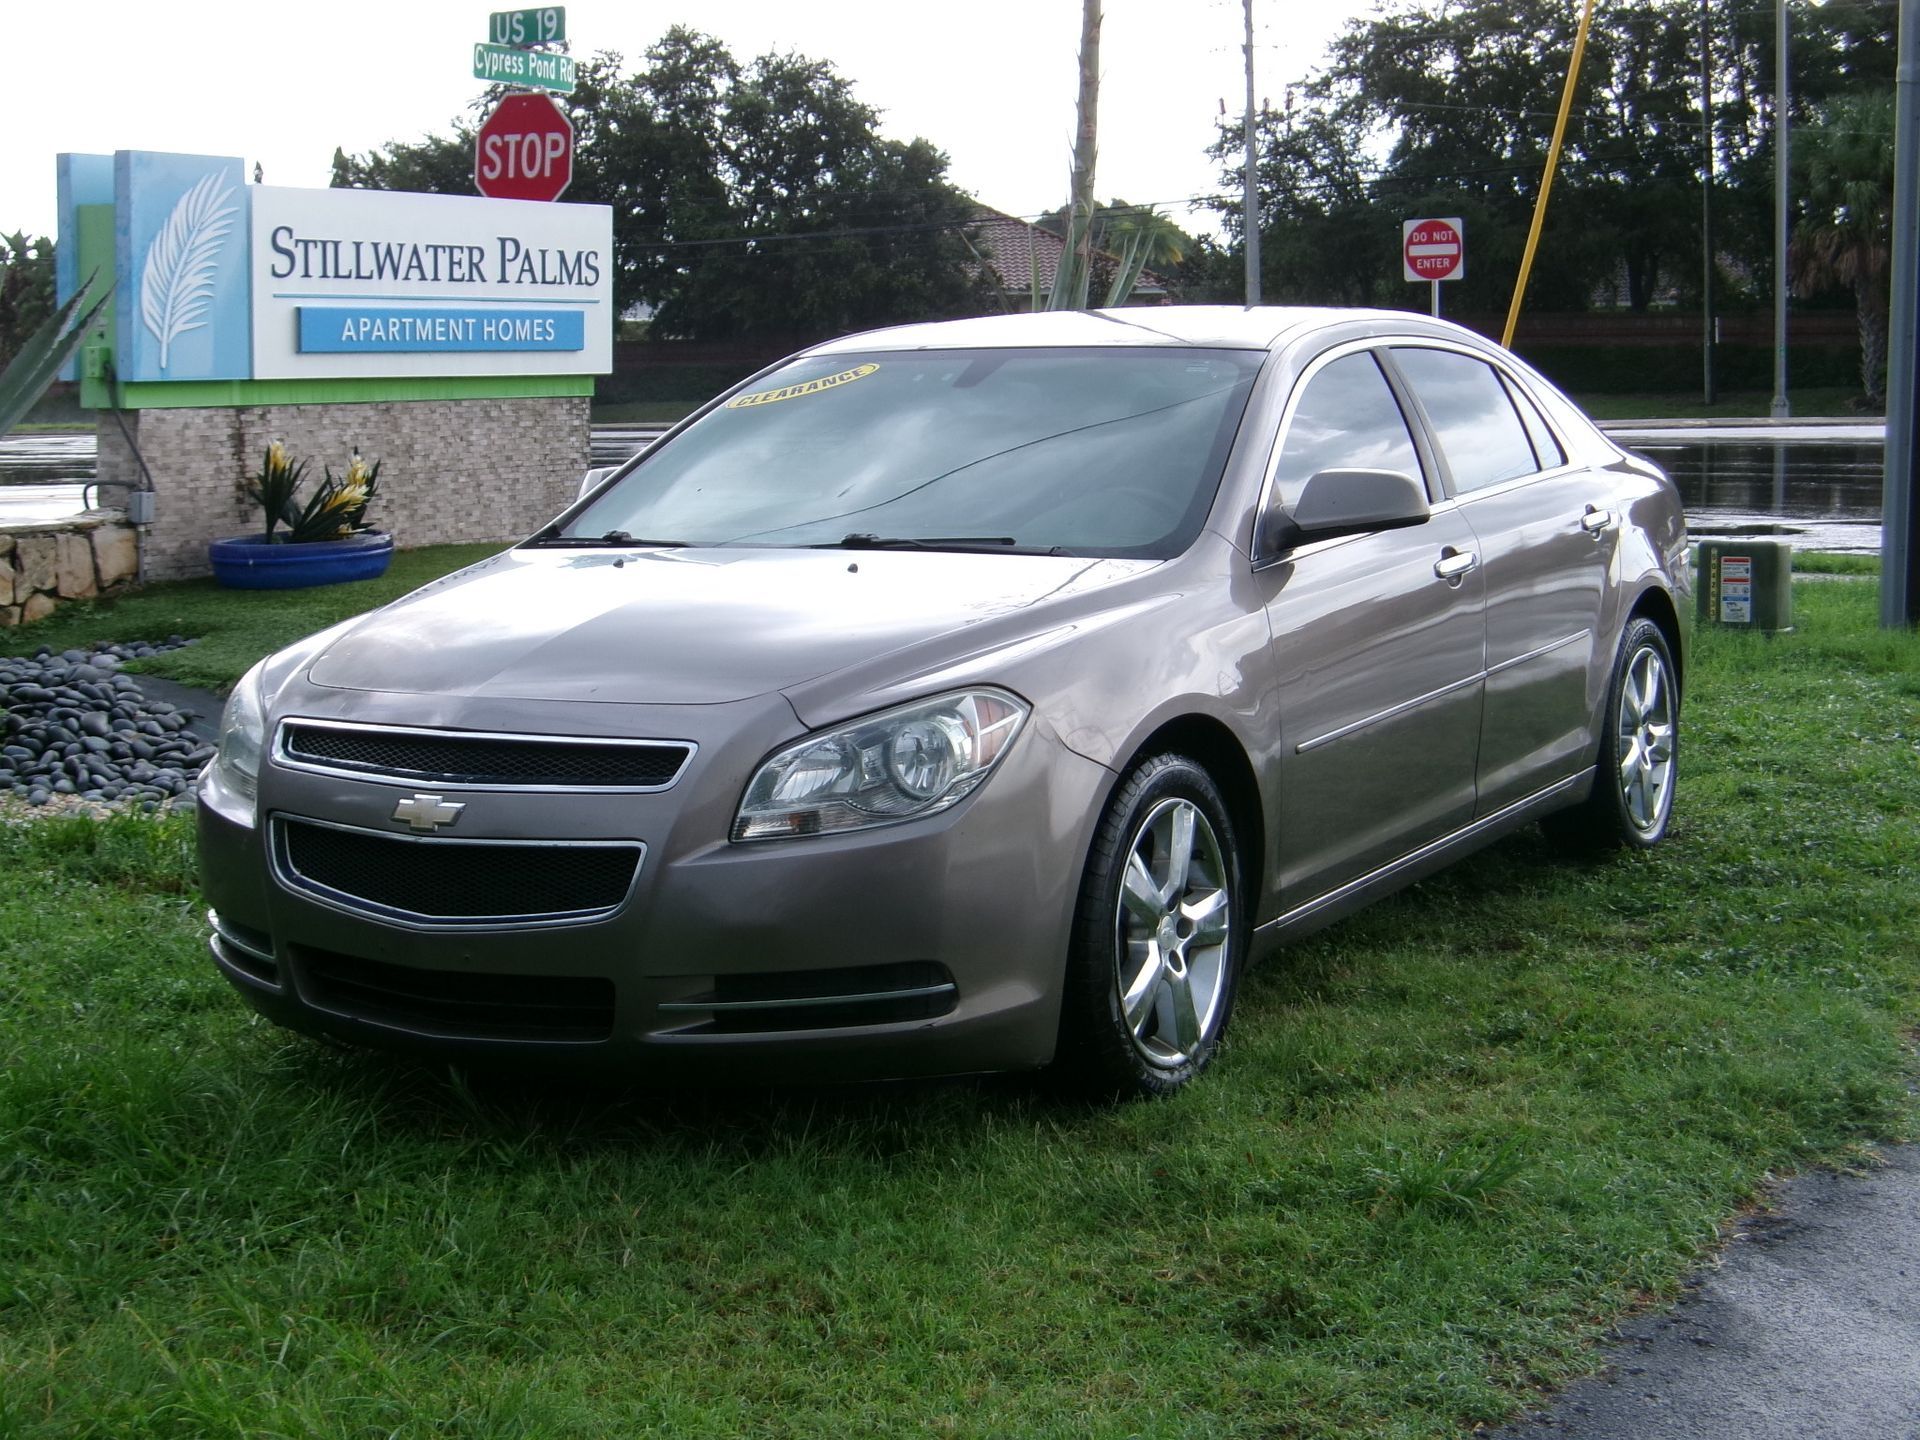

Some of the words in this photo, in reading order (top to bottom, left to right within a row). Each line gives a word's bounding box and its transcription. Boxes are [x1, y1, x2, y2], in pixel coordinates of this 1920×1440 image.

[496, 12, 525, 44] US
[536, 8, 558, 41] 19
[474, 45, 524, 78] Cypress
[528, 52, 556, 80] Pond
[560, 58, 573, 83] Rd
[482, 132, 566, 180] STOP
[1413, 232, 1427, 242] DO
[1433, 230, 1453, 241] NOT
[270, 225, 488, 283] STILLWATER
[497, 236, 600, 287] PALMS
[1416, 258, 1449, 269] ENTER
[341, 318, 476, 343] APARTMENT
[483, 318, 556, 343] HOMES
[736, 368, 866, 406] CLEARANCE
